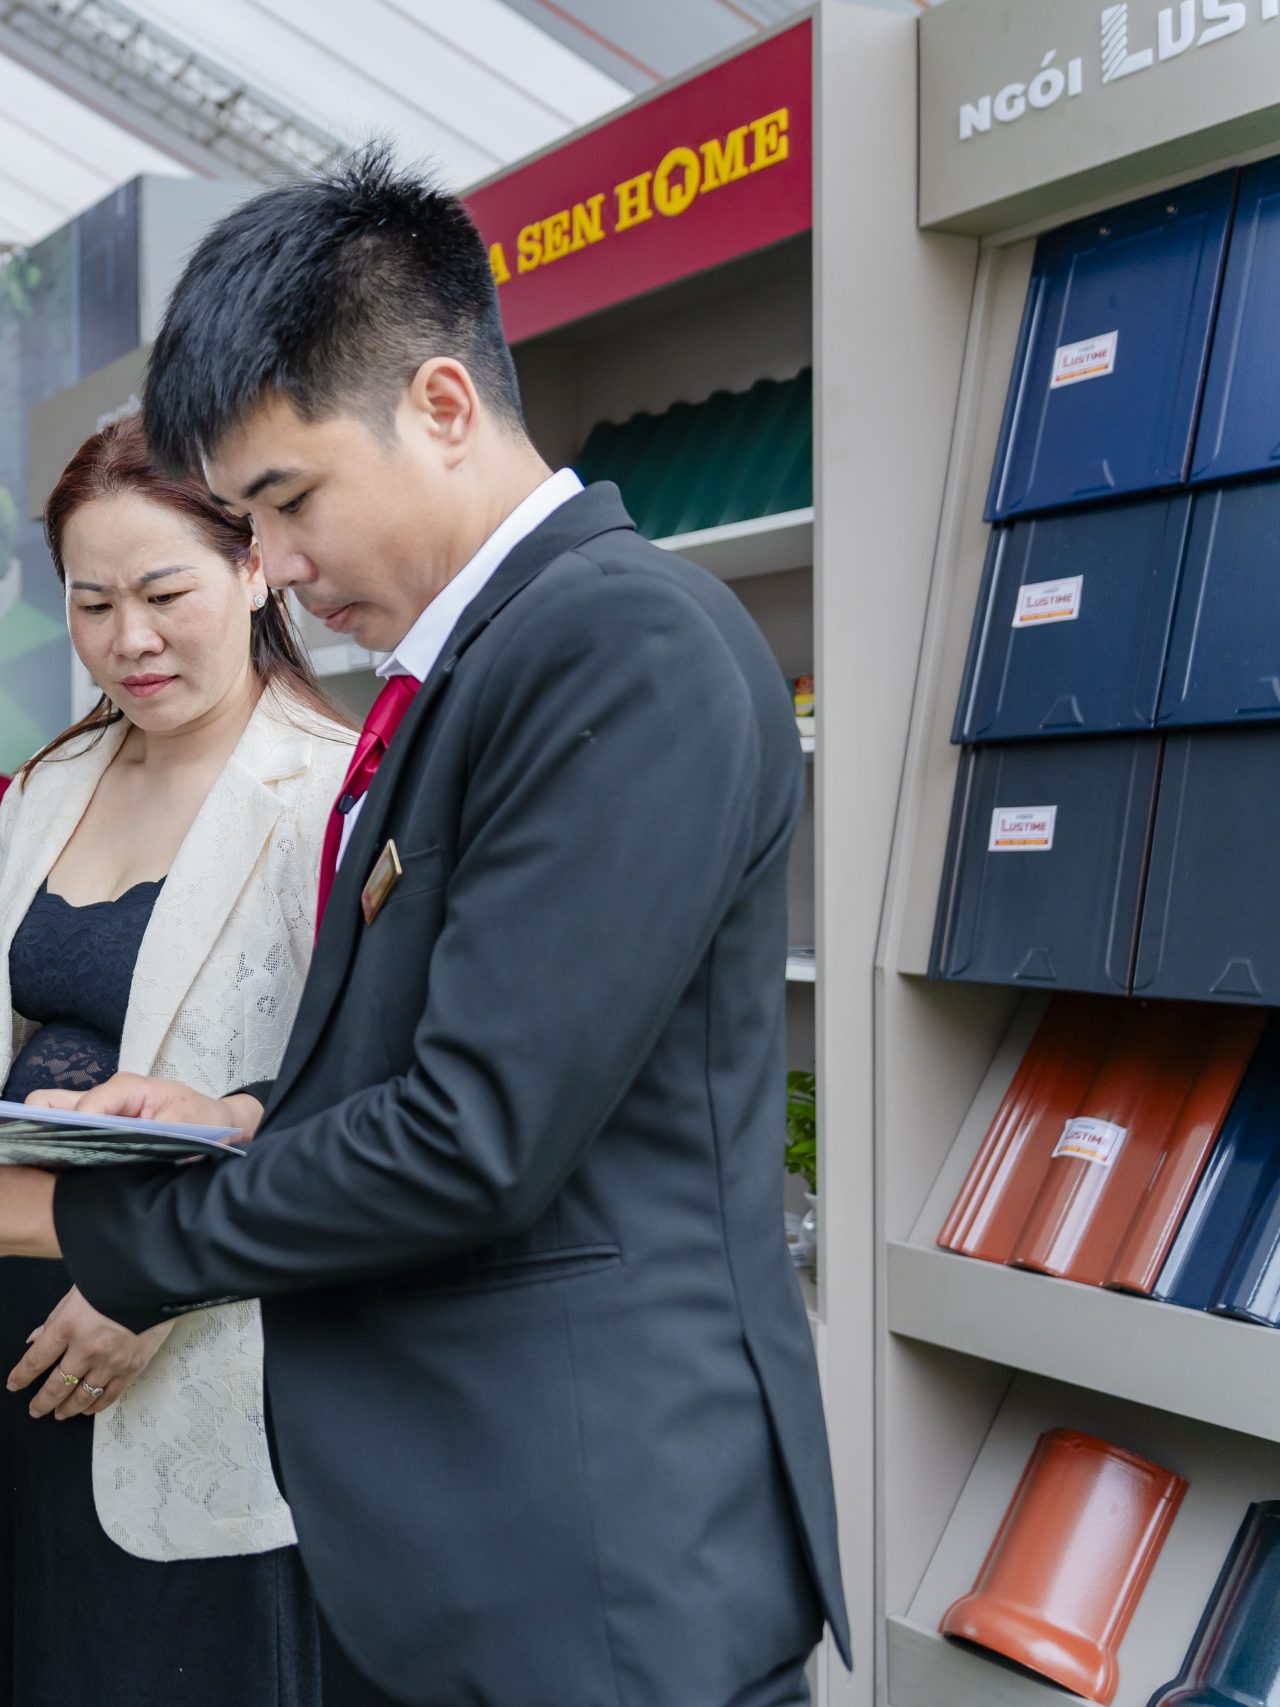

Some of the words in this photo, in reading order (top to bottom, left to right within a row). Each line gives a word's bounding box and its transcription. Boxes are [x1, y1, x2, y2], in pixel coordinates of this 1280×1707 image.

[959, 49, 1082, 140] NGÓI
[1100, 0, 1278, 83] LUS
[517, 193, 605, 273] SEN
[615, 108, 789, 232] HOME
